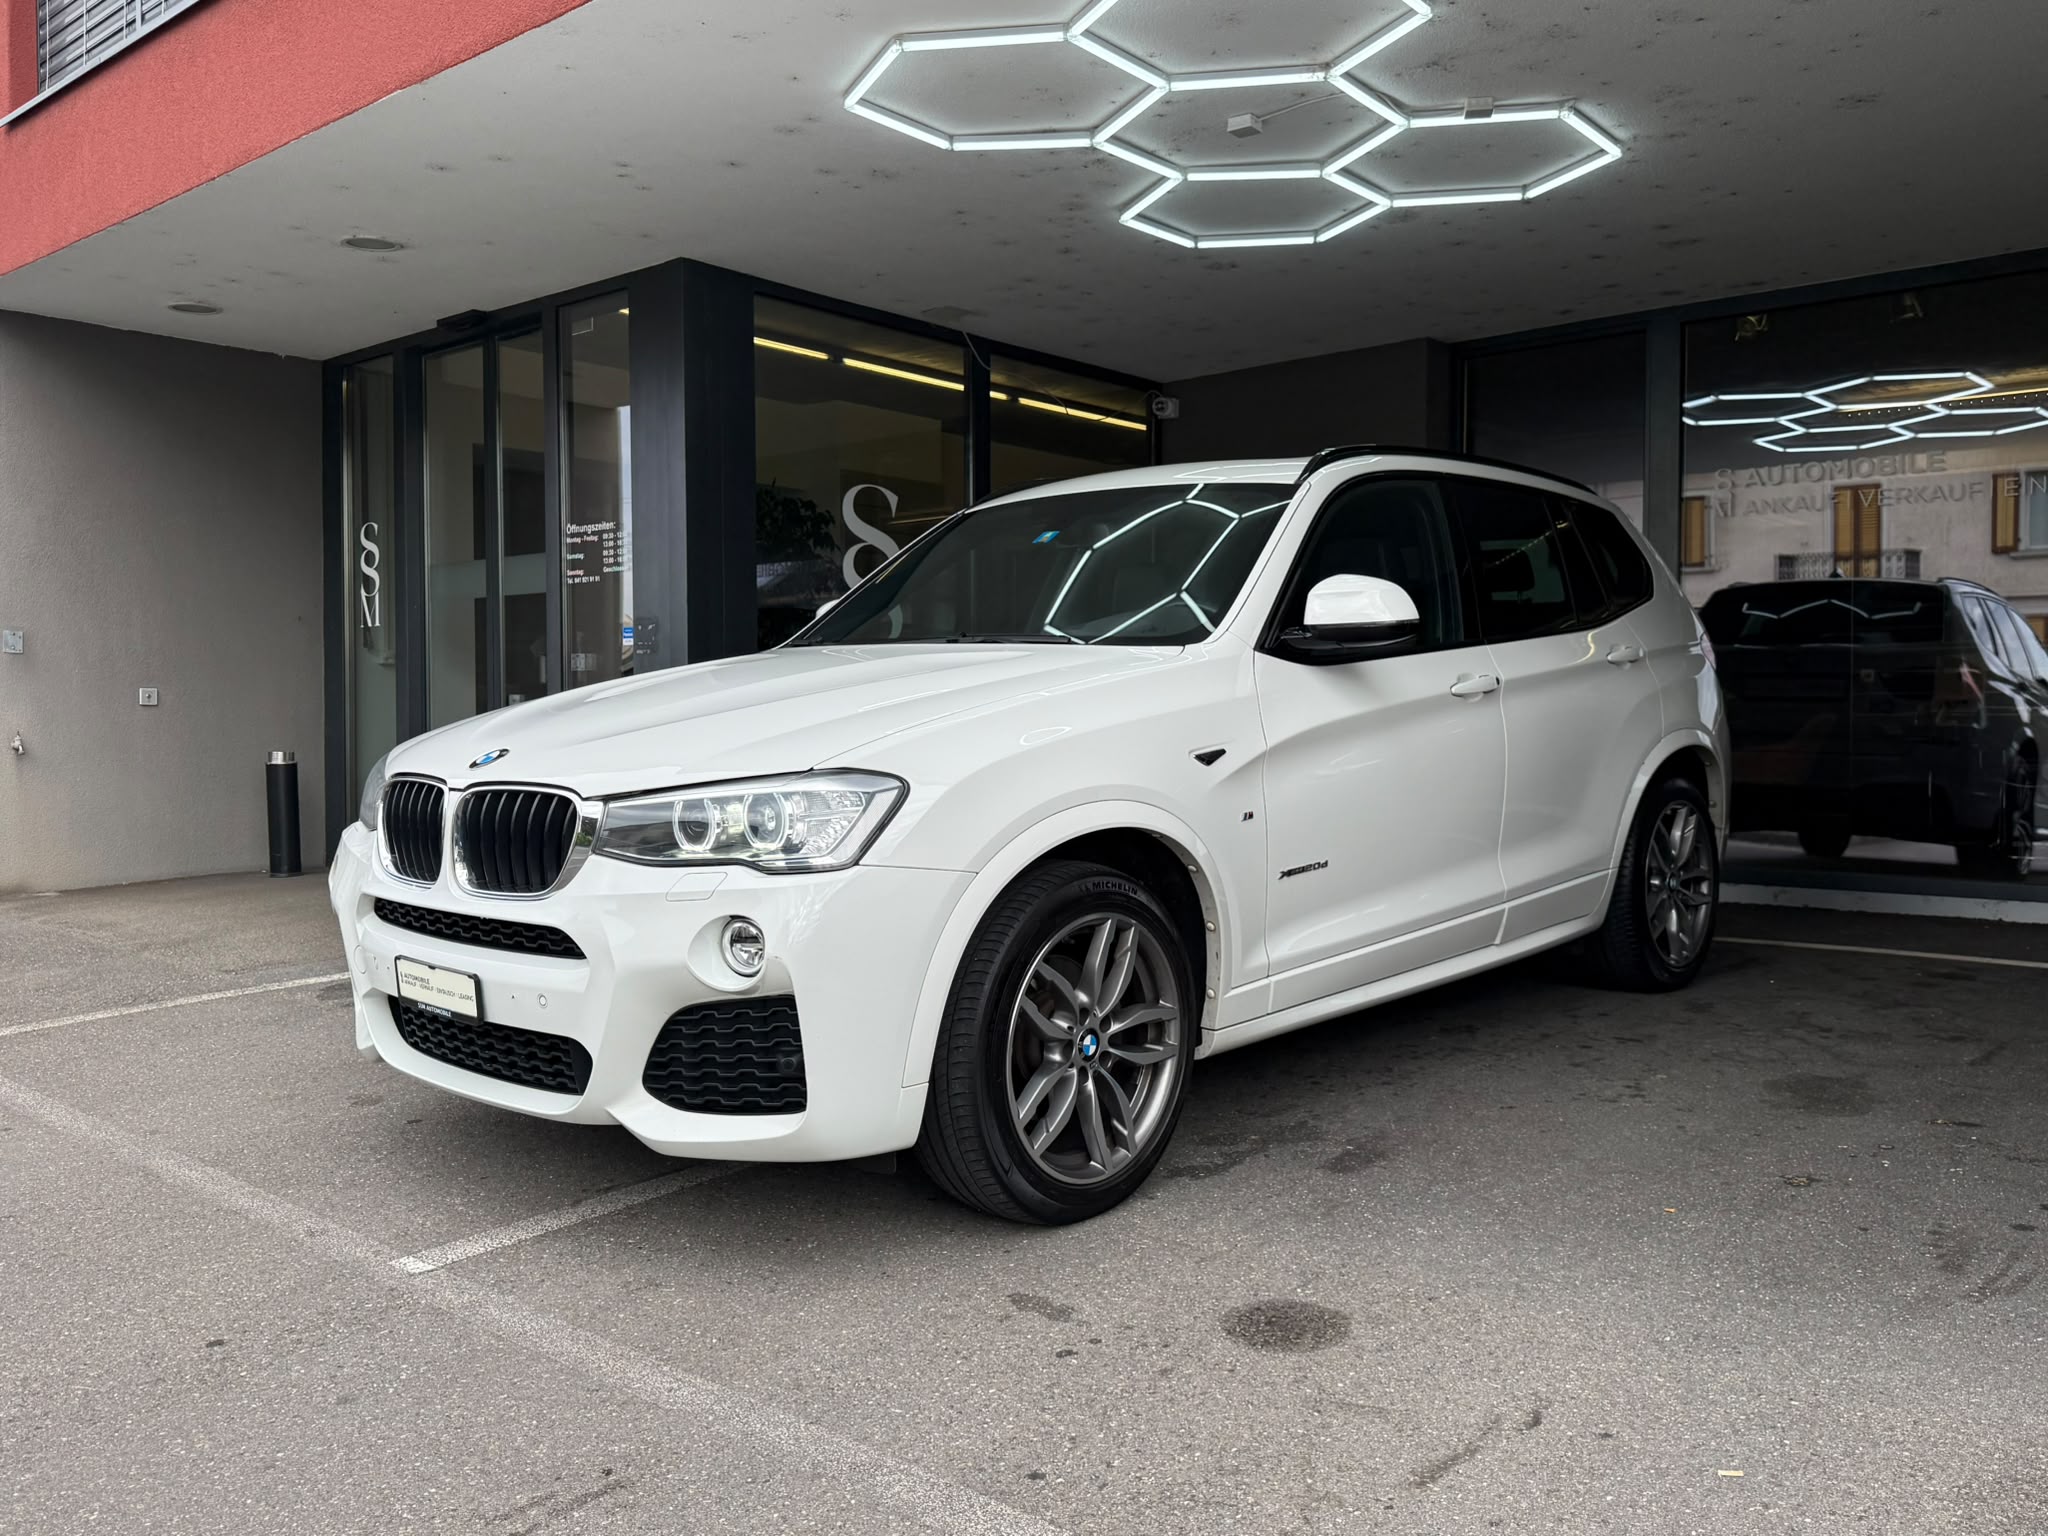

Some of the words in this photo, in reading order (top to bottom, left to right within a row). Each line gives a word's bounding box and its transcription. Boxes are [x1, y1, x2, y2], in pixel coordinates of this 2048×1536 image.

[1745, 451, 1947, 487] AUTOMOBILE
[1744, 492, 1838, 517] ANKAUF
[1858, 481, 1985, 508] VERKAUF
[566, 521, 616, 534] Öffnungszeiten:
[1092, 880, 1138, 896] MICHELIN
